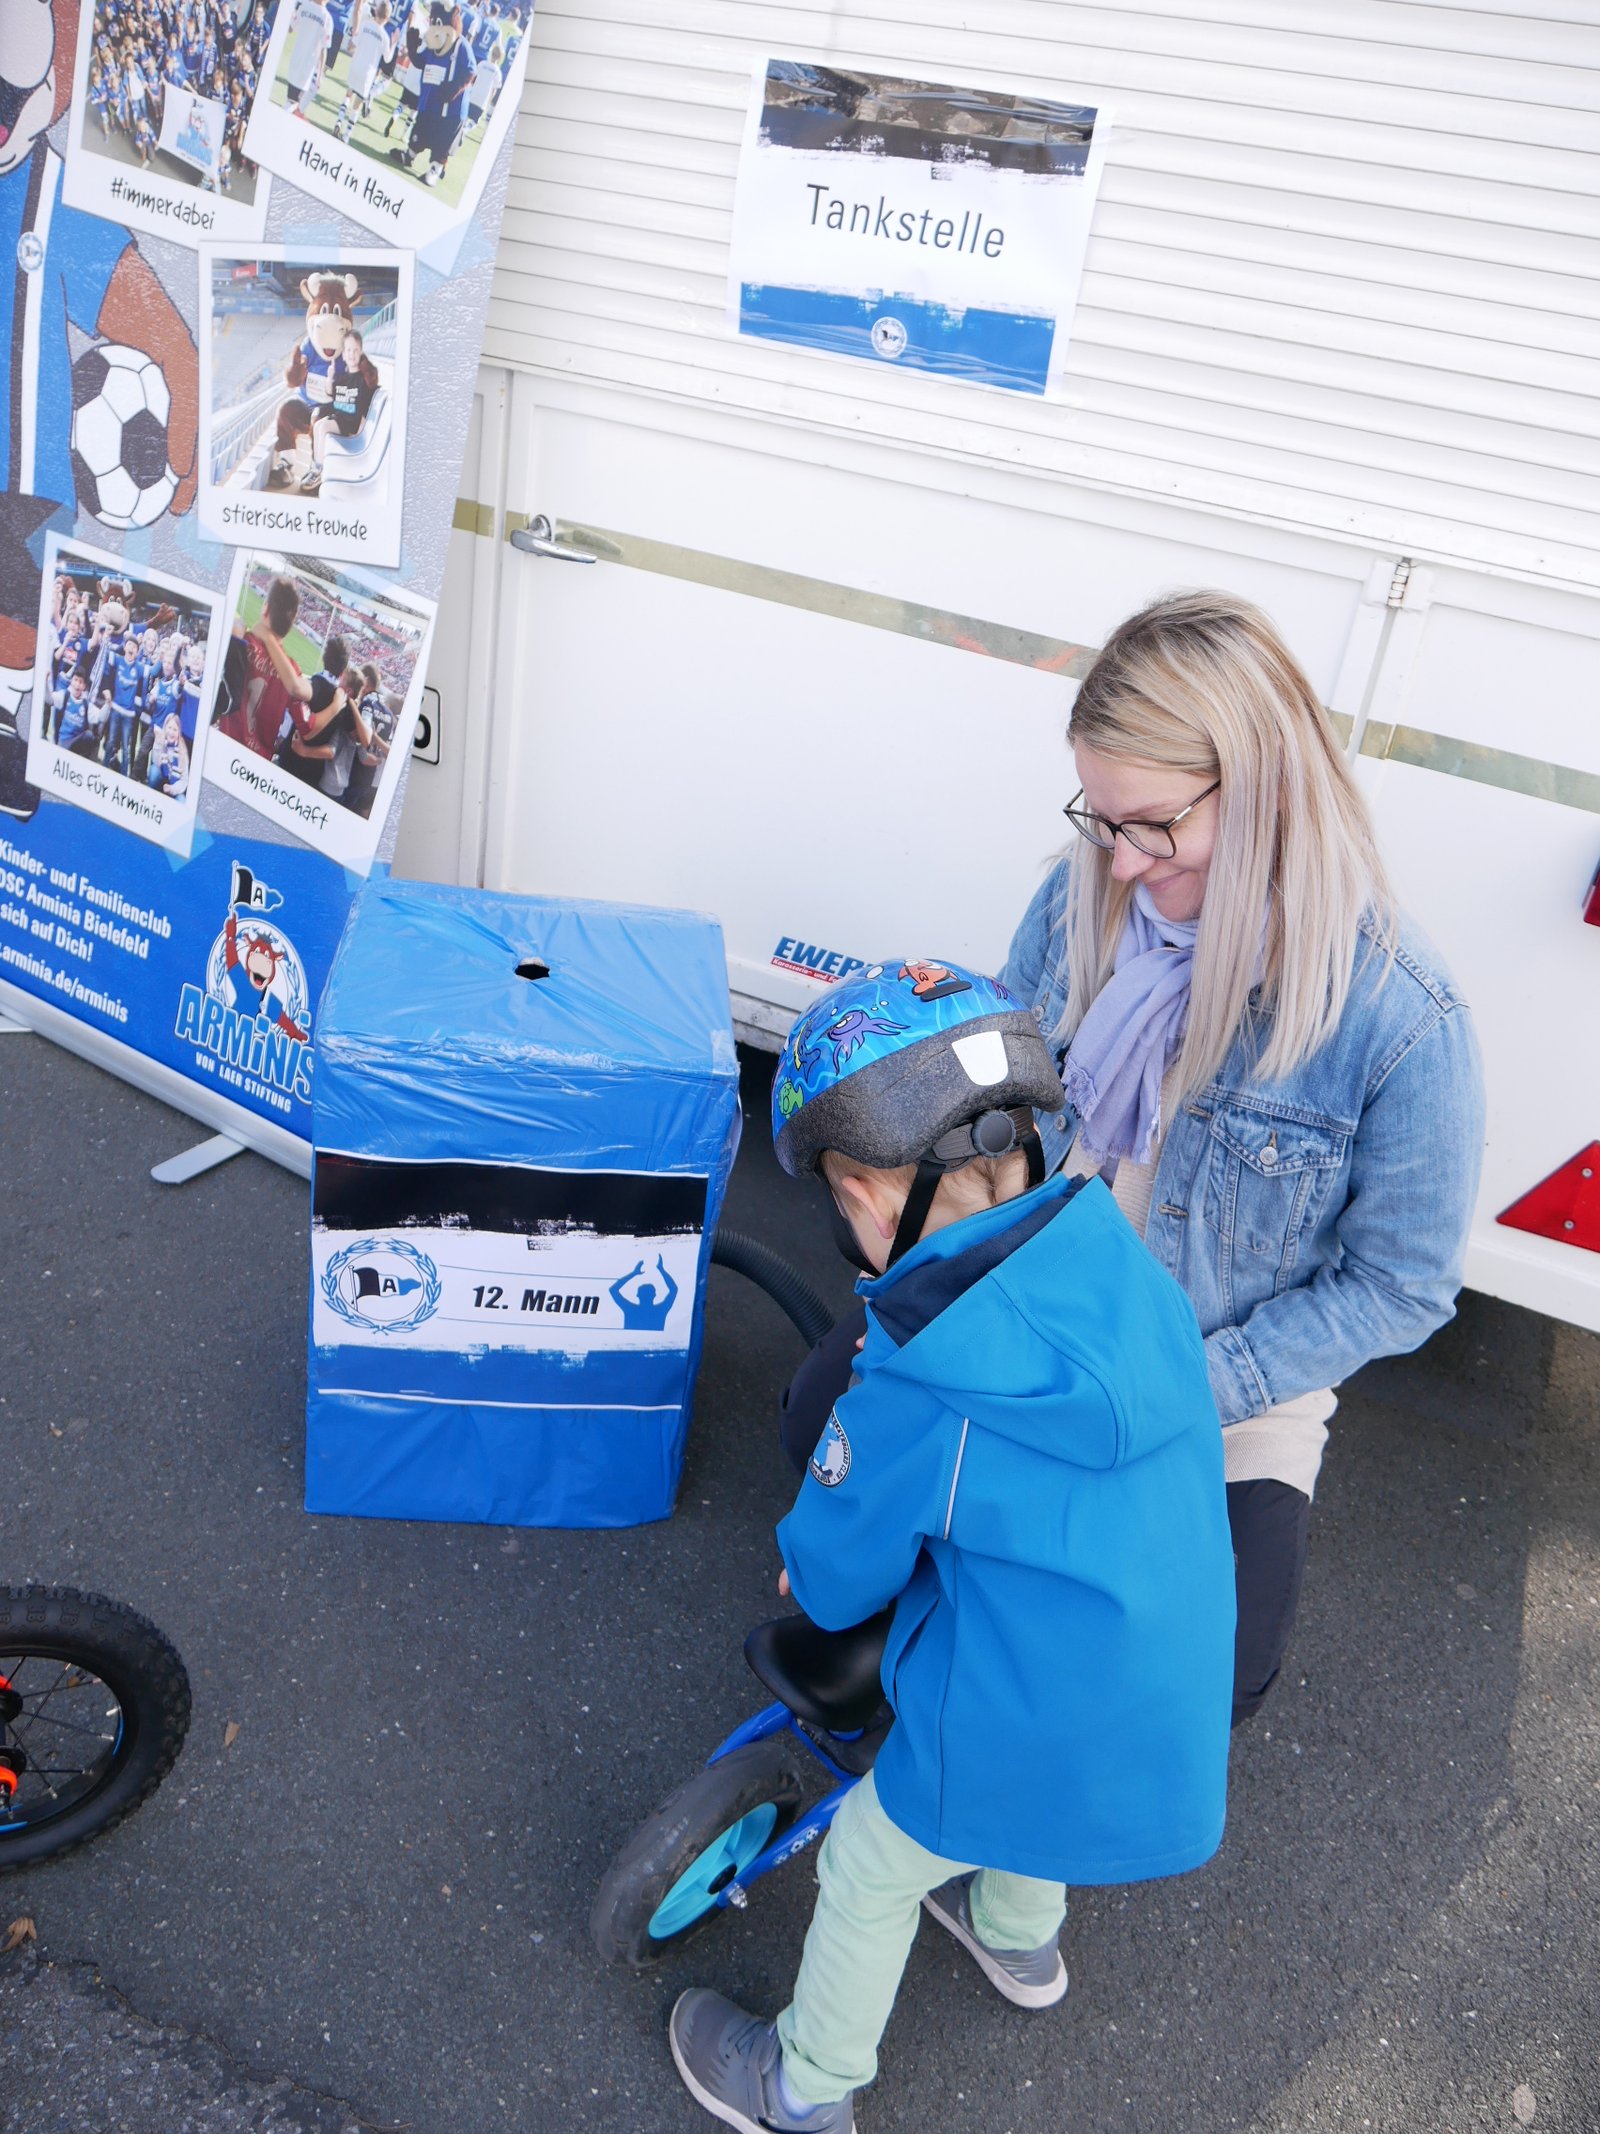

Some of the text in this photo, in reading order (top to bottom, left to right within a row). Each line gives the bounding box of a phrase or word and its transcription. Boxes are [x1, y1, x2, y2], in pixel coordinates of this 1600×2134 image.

[111, 177, 215, 230] #immerdabei
[299, 142, 404, 219] Hand in Hand
[806, 183, 1005, 258] Tankstelle
[222, 503, 302, 532] stierische
[53, 759, 83, 787] Alles
[111, 786, 163, 825] Arminia
[230, 759, 329, 830] Gemeinschaft
[0, 839, 172, 939] Kinder- und Familienclub
[253, 887, 263, 905] A
[0, 902, 94, 962] sich auf Dich!
[26, 882, 81, 926] Arminia
[84, 909, 150, 960] Bielefeld
[774, 936, 874, 978] EWER
[196, 1051, 292, 1113] VON LAER STIFTUNG
[382, 1278, 396, 1293] A
[473, 1285, 600, 1315] 12. Mann
